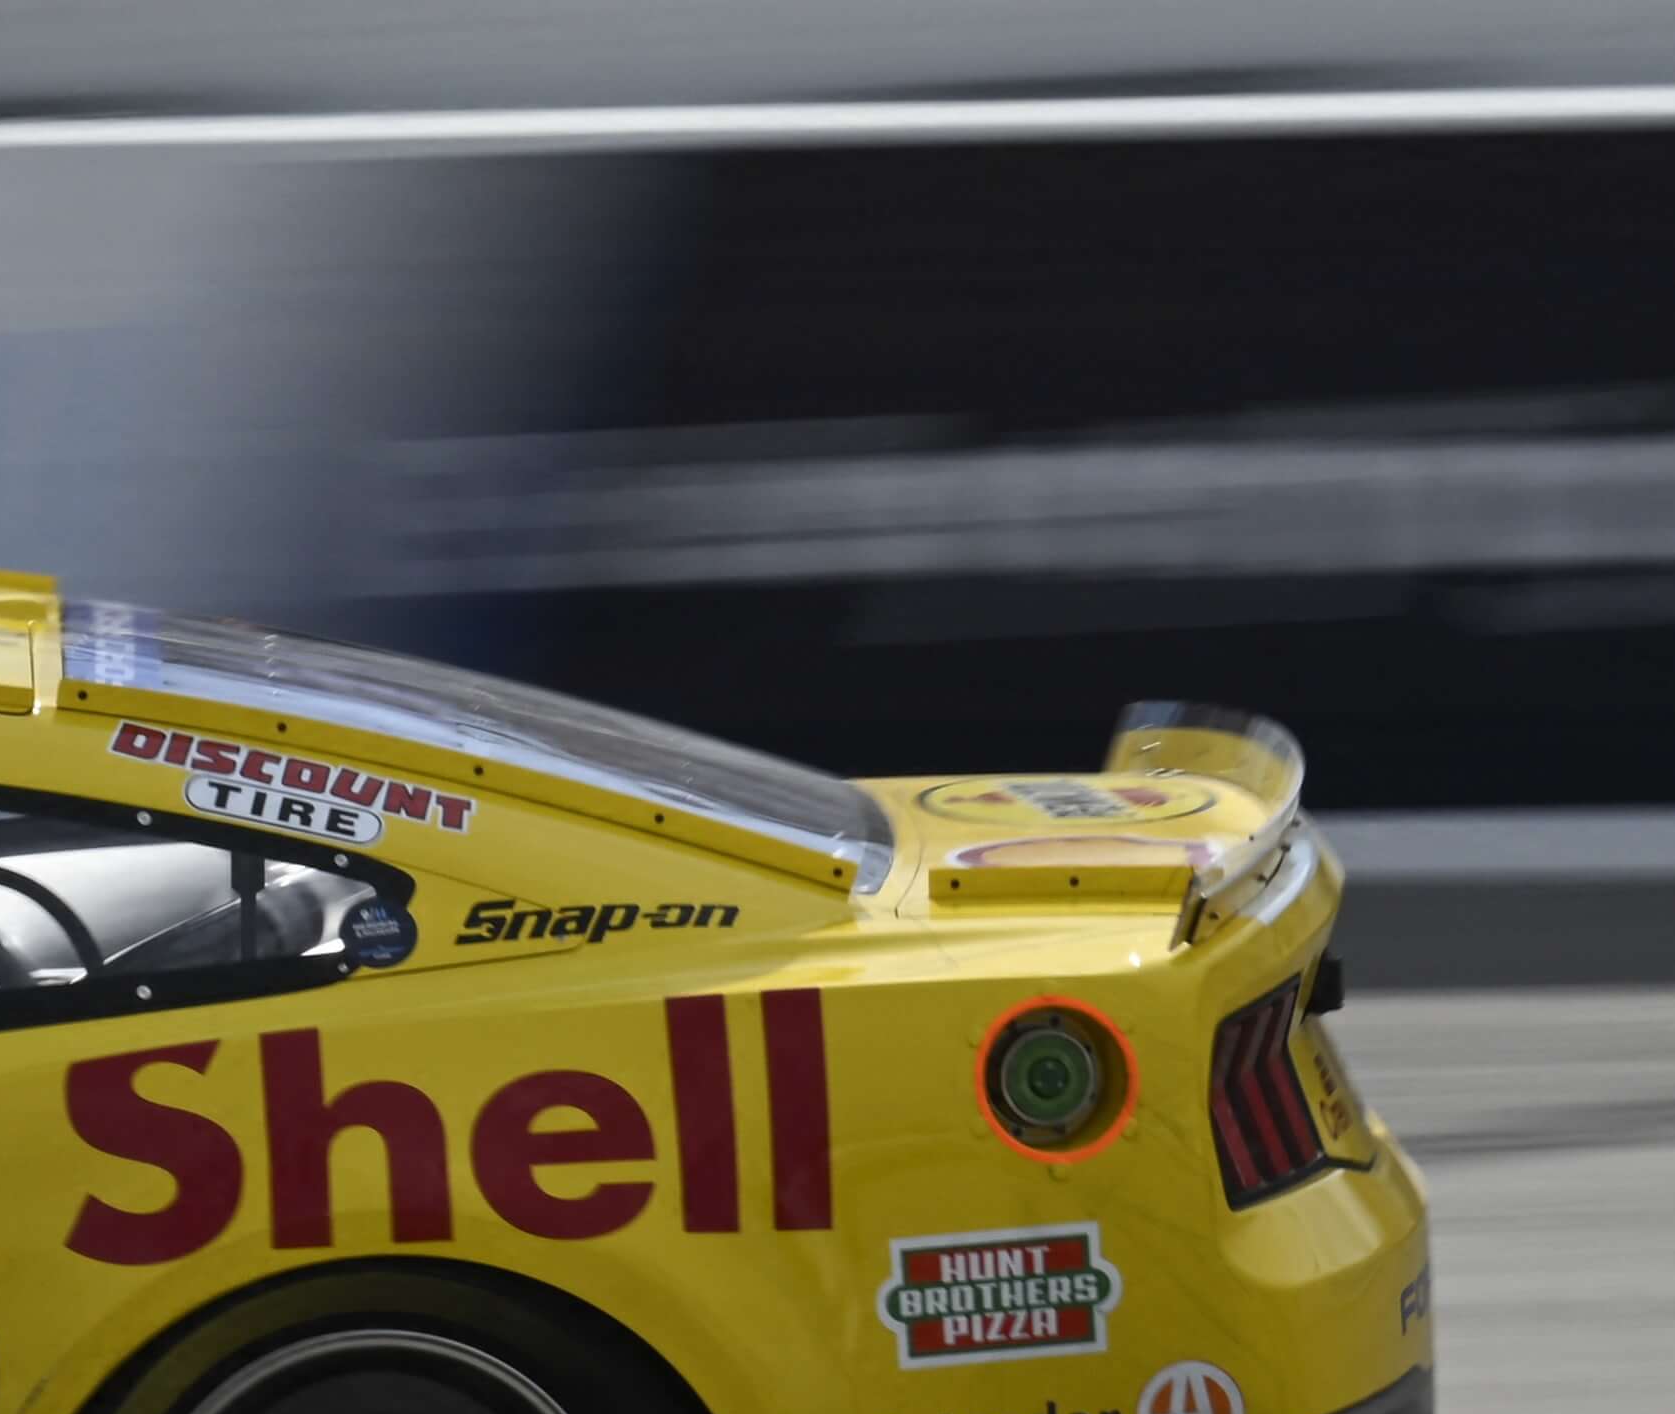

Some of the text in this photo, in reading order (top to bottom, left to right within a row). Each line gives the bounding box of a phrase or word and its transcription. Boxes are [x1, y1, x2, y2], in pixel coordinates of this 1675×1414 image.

[111, 721, 475, 832] DISCOUNT
[208, 781, 361, 837] TIRE
[454, 897, 739, 945] Snap-on
[63, 988, 833, 1266] Shell
[939, 1246, 1049, 1283] HUNT
[900, 1273, 1098, 1317] BROTHERS
[942, 1307, 1057, 1345] PIZZA
